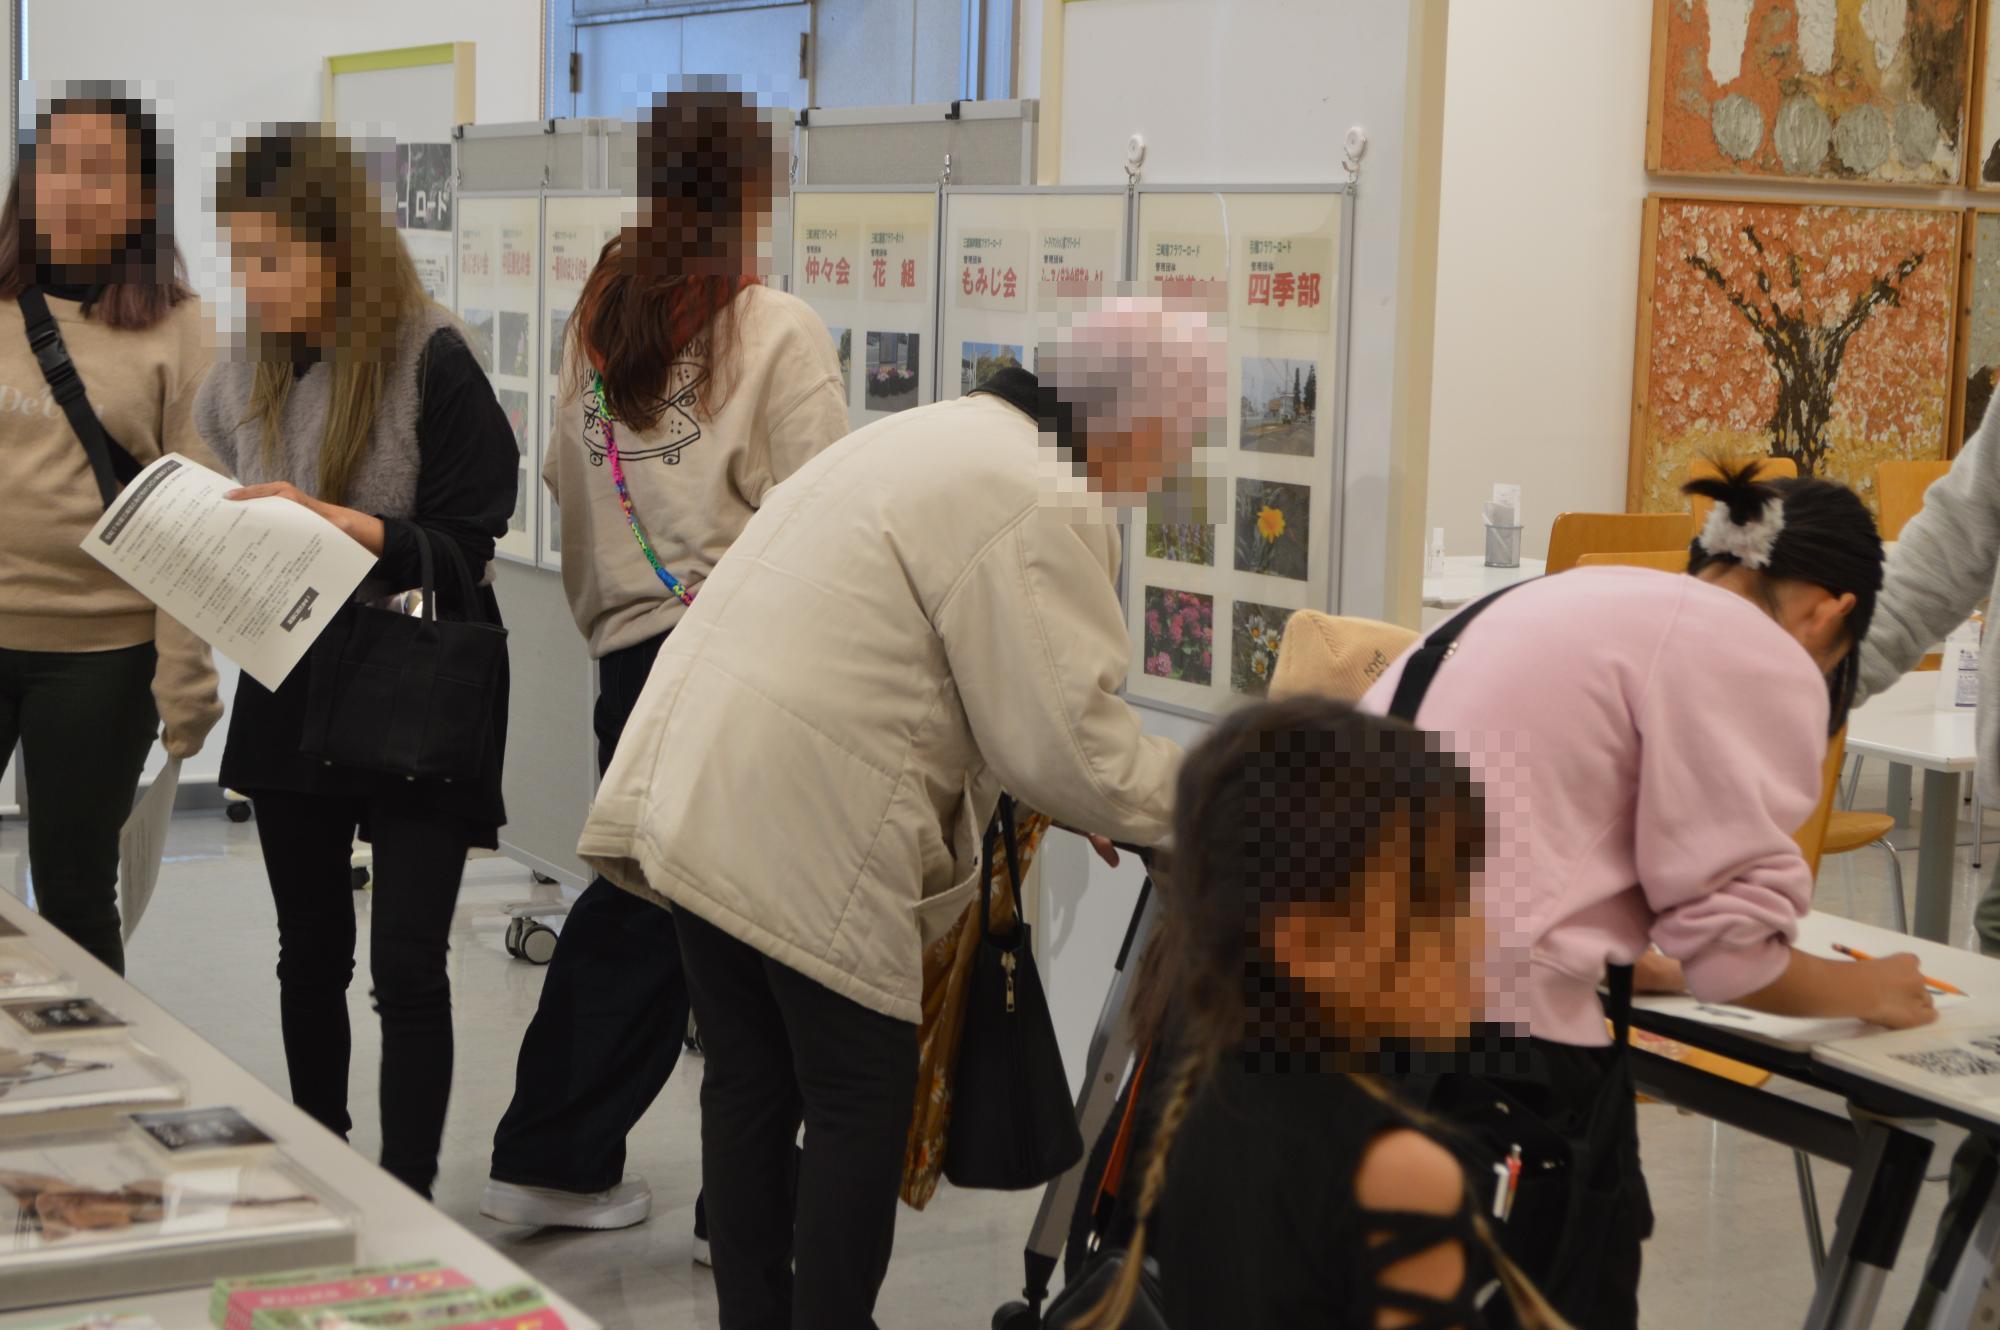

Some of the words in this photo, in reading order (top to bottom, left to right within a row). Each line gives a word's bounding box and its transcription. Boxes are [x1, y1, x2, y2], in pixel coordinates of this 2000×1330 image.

[805, 255, 850, 285] 仲々会
[873, 258, 887, 288] 花
[901, 259, 915, 288] 組
[962, 267, 1017, 298] もみじ会
[1247, 272, 1321, 308] 四季部
